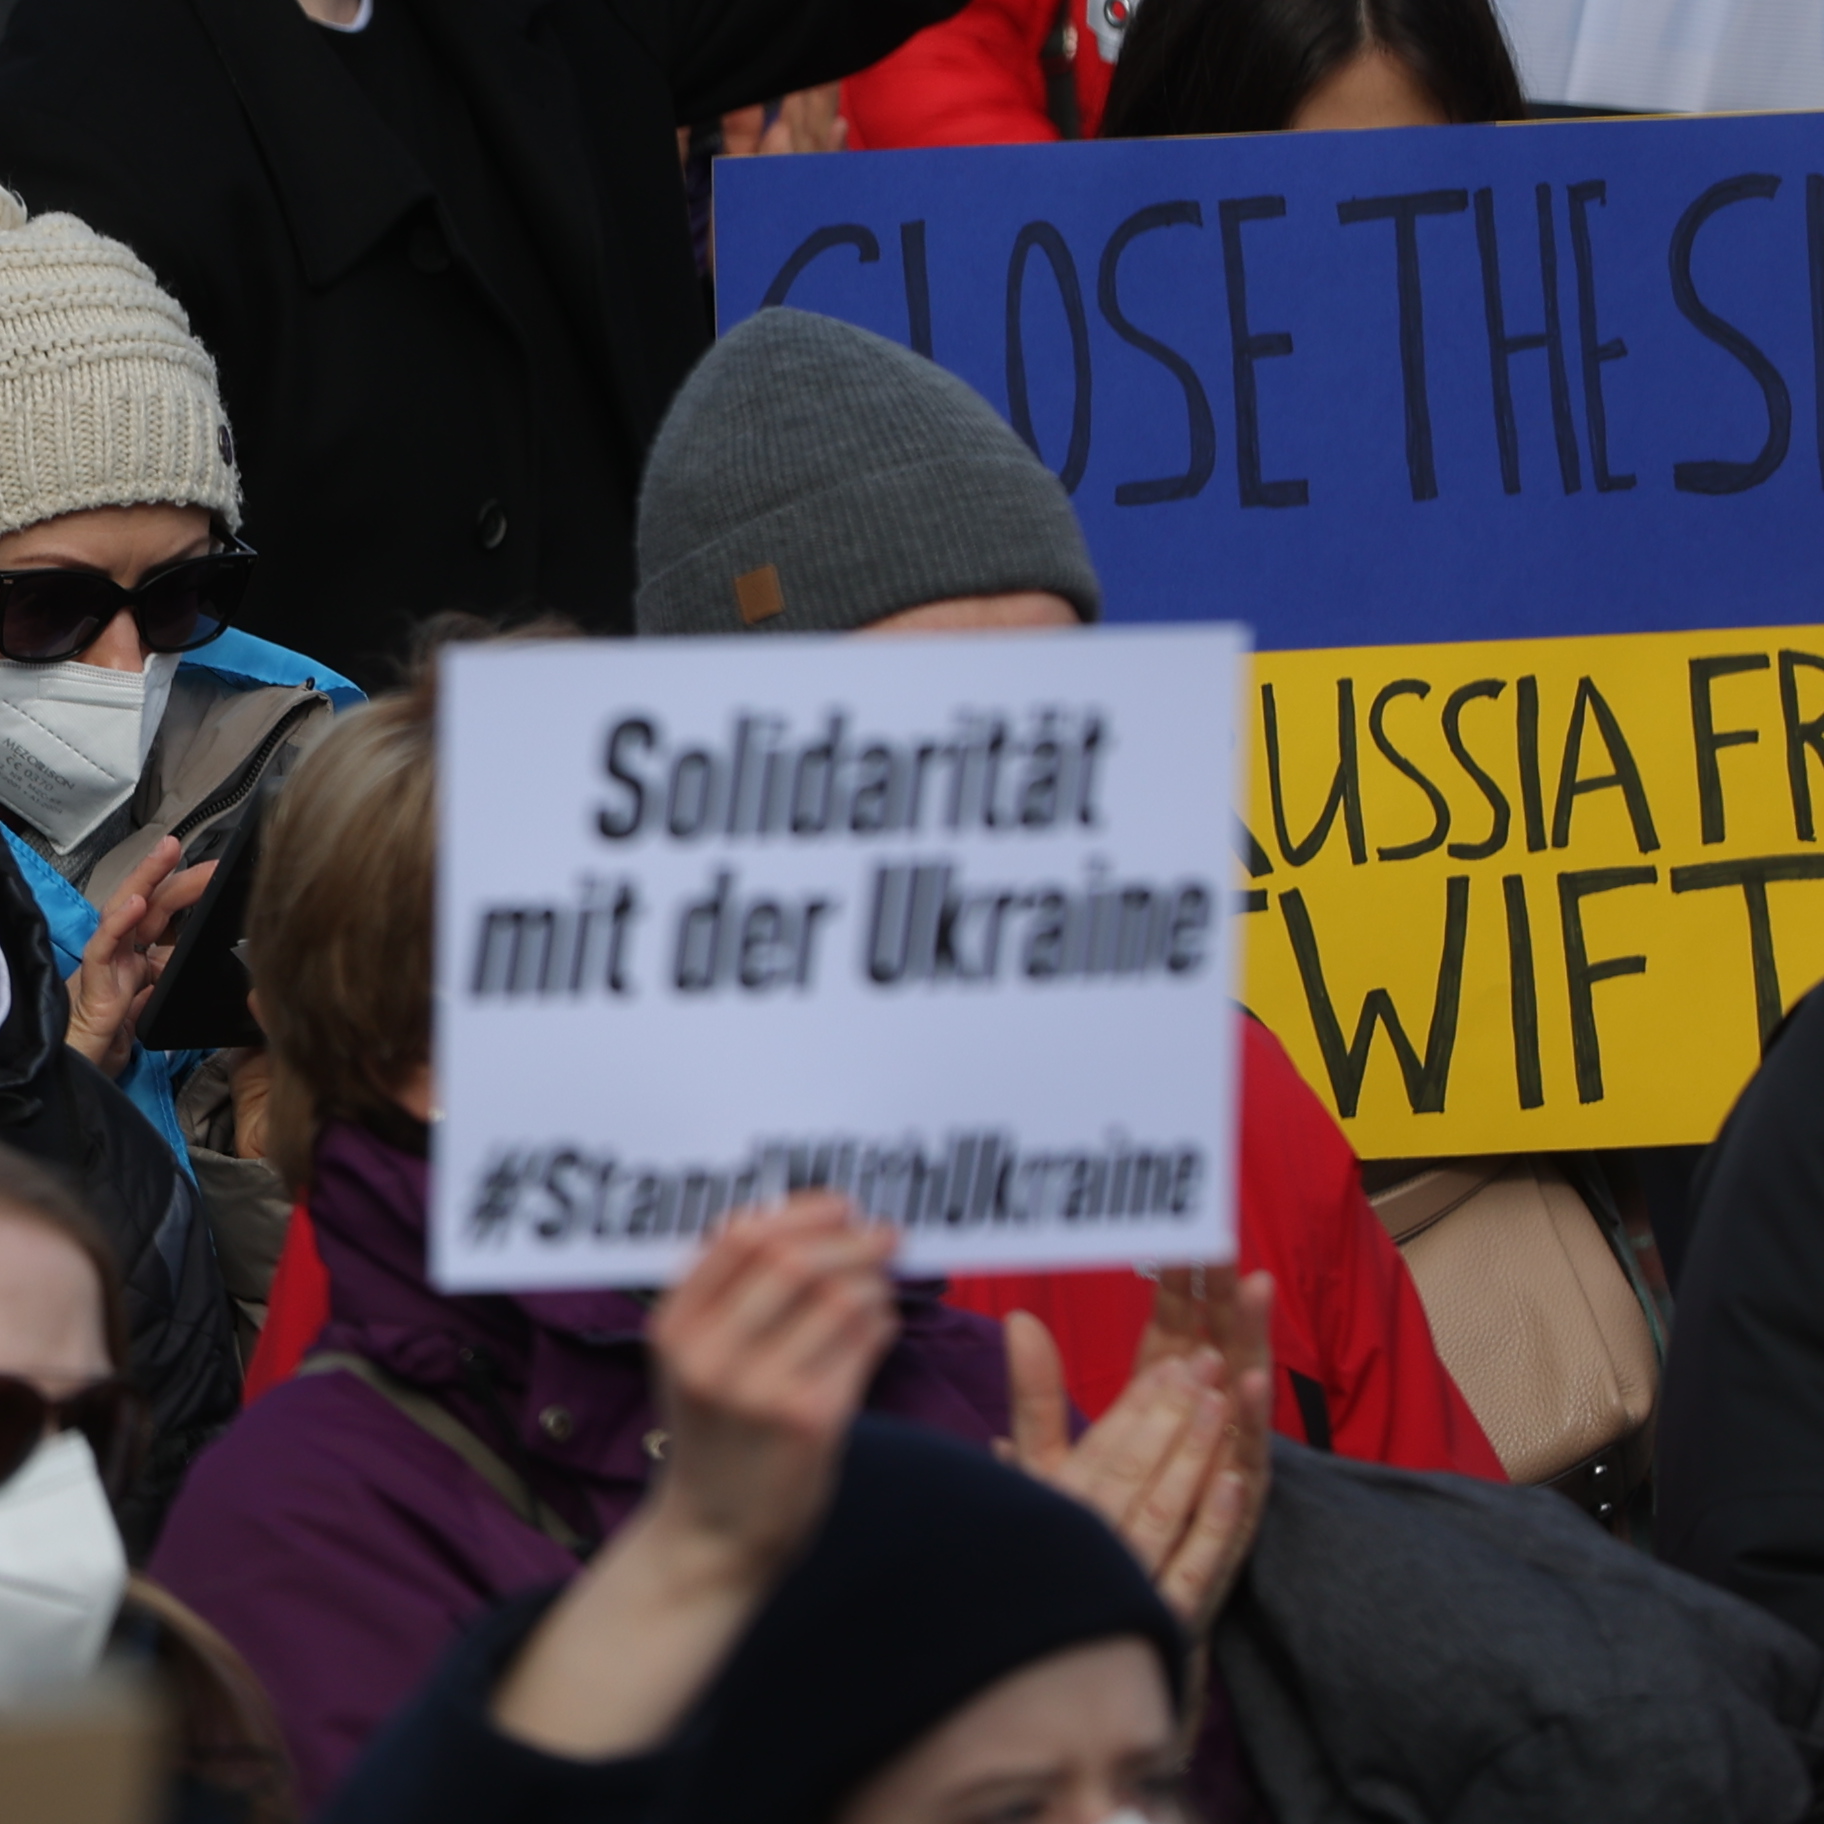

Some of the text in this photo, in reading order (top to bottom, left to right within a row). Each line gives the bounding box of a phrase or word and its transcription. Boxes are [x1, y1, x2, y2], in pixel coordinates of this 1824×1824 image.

[1336, 180, 1639, 503] THE
[1667, 173, 1824, 498] S
[1, 737, 76, 791] MEZORISON
[592, 708, 1110, 846] Solidarität
[1230, 674, 1661, 878] USSIA
[468, 858, 1218, 1004] mit der Ukraine
[1228, 853, 1824, 1119] WIFT
